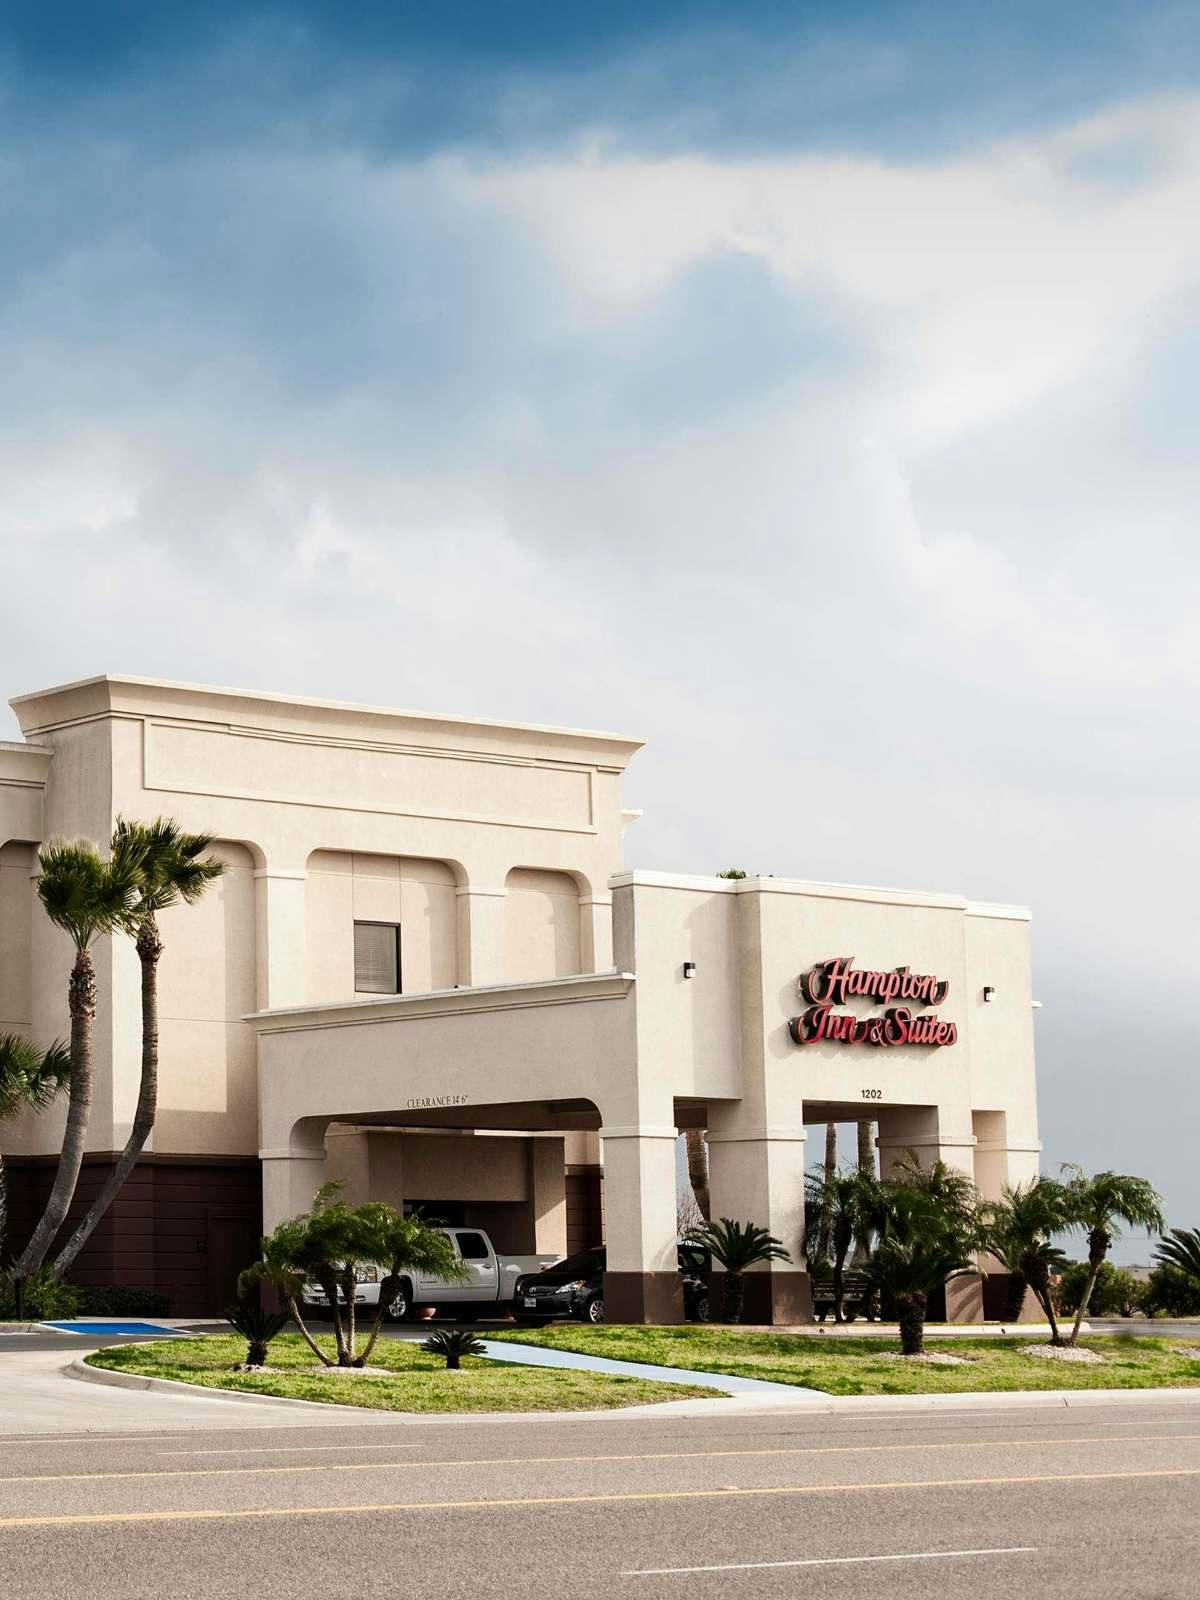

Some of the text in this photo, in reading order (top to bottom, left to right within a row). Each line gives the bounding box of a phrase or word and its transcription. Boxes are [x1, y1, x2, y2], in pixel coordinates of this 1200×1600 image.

[804, 956, 949, 1006] Hampton
[794, 1005, 958, 1047] Inn & Suites
[407, 1096, 451, 1108] CLEARANCE
[861, 1089, 882, 1099] 1202
